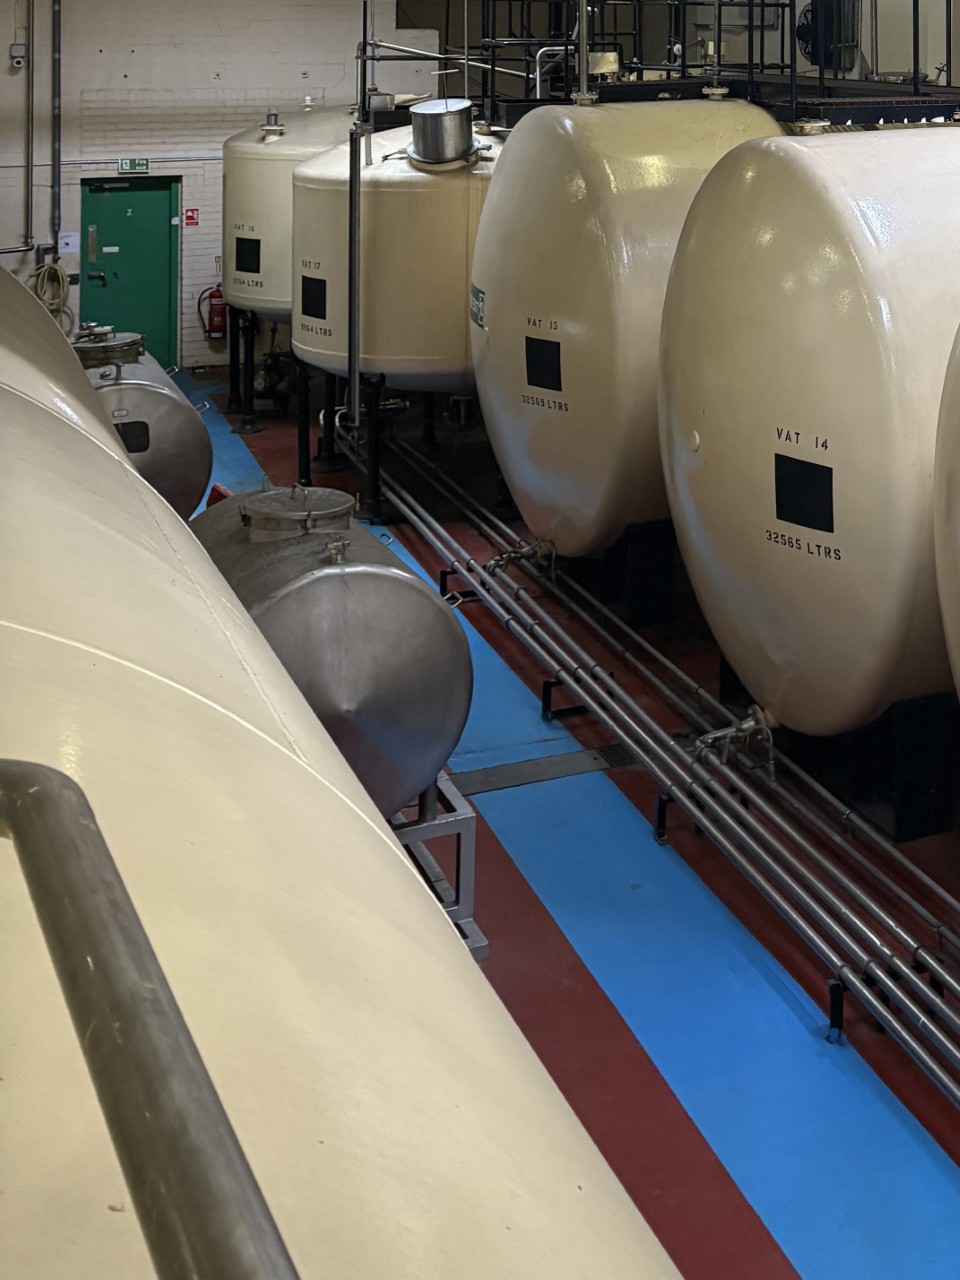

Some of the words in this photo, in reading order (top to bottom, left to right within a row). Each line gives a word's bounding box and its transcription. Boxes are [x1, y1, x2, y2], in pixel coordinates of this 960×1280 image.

[302, 260, 311, 269] VAT
[314, 261, 321, 270] 17
[247, 280, 264, 288] LTRS
[526, 316, 542, 328] VAT
[549, 320, 558, 330] 15
[315, 327, 332, 337] LTRS
[547, 399, 569, 412] LTRS
[776, 427, 800, 444] VAT
[815, 436, 829, 451] 14
[765, 529, 802, 551] 32565
[807, 542, 842, 561] LTRS
